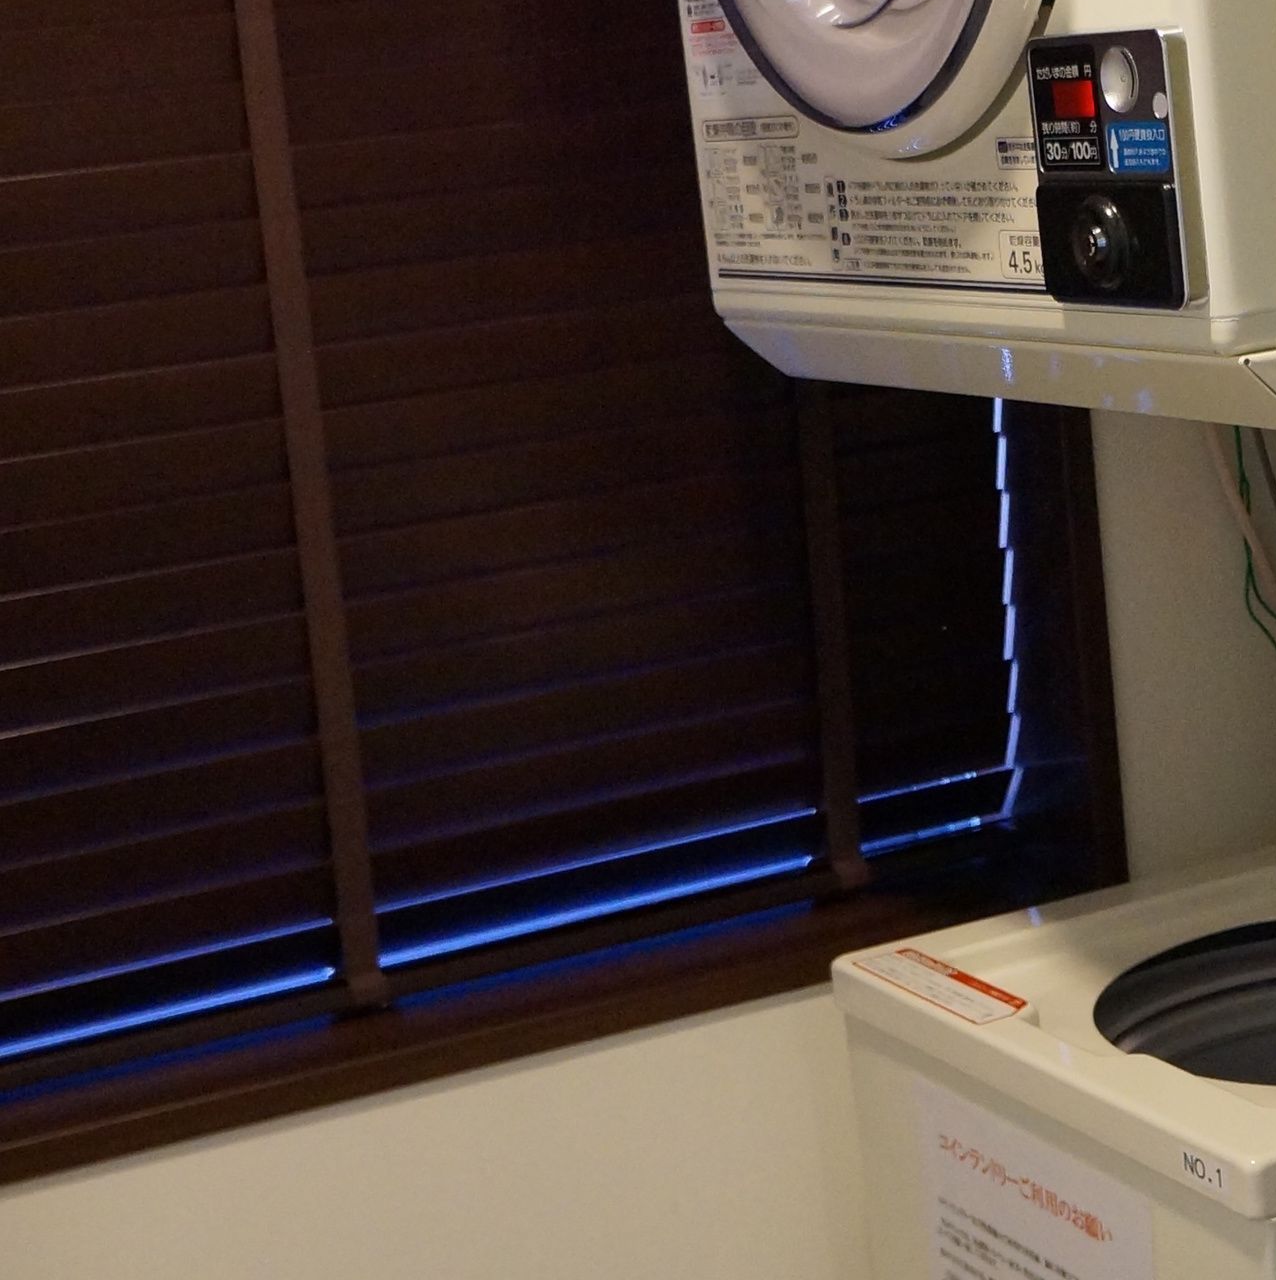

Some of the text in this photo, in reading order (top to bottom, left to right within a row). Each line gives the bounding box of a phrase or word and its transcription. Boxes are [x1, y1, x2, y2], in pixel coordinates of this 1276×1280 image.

[1083, 64, 1092, 78] 円
[1089, 121, 1097, 134] 分
[1008, 250, 1032, 274] 4.5
[1183, 1151, 1222, 1188] NO.1
